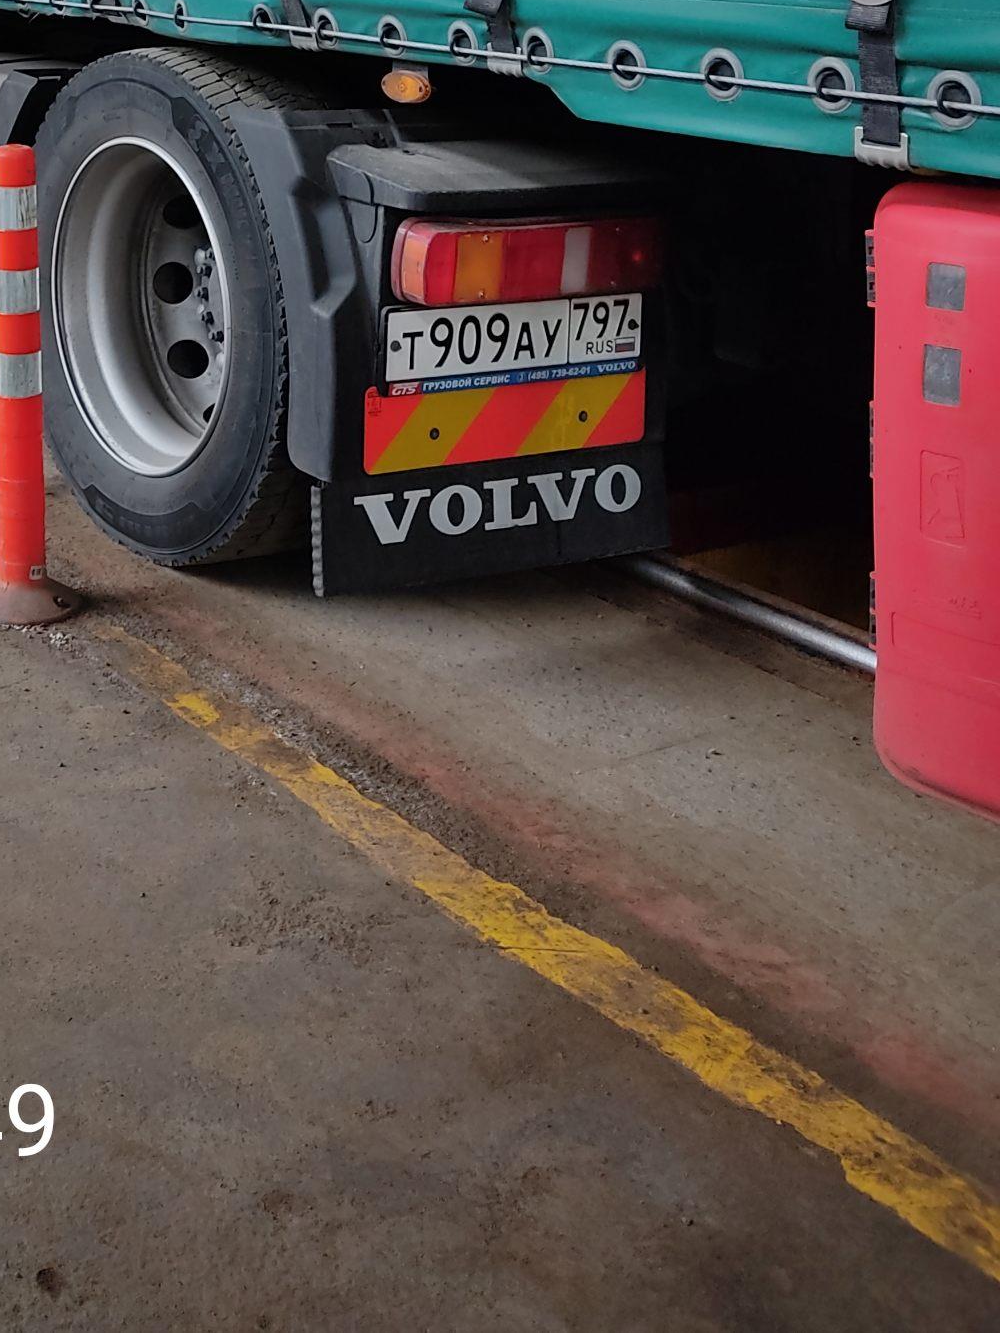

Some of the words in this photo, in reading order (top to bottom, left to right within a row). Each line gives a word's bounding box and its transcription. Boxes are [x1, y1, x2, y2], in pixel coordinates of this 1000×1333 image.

[402, 313, 562, 371] Т909АУ
[573, 299, 630, 341] 797
[586, 340, 614, 355] RUS
[391, 383, 419, 396] GTS
[422, 377, 472, 392] ГРУЗОВОЙ
[474, 374, 511, 386] СЕРВИС
[597, 360, 636, 373] VOLVO
[353, 464, 642, 545] VOLVO
